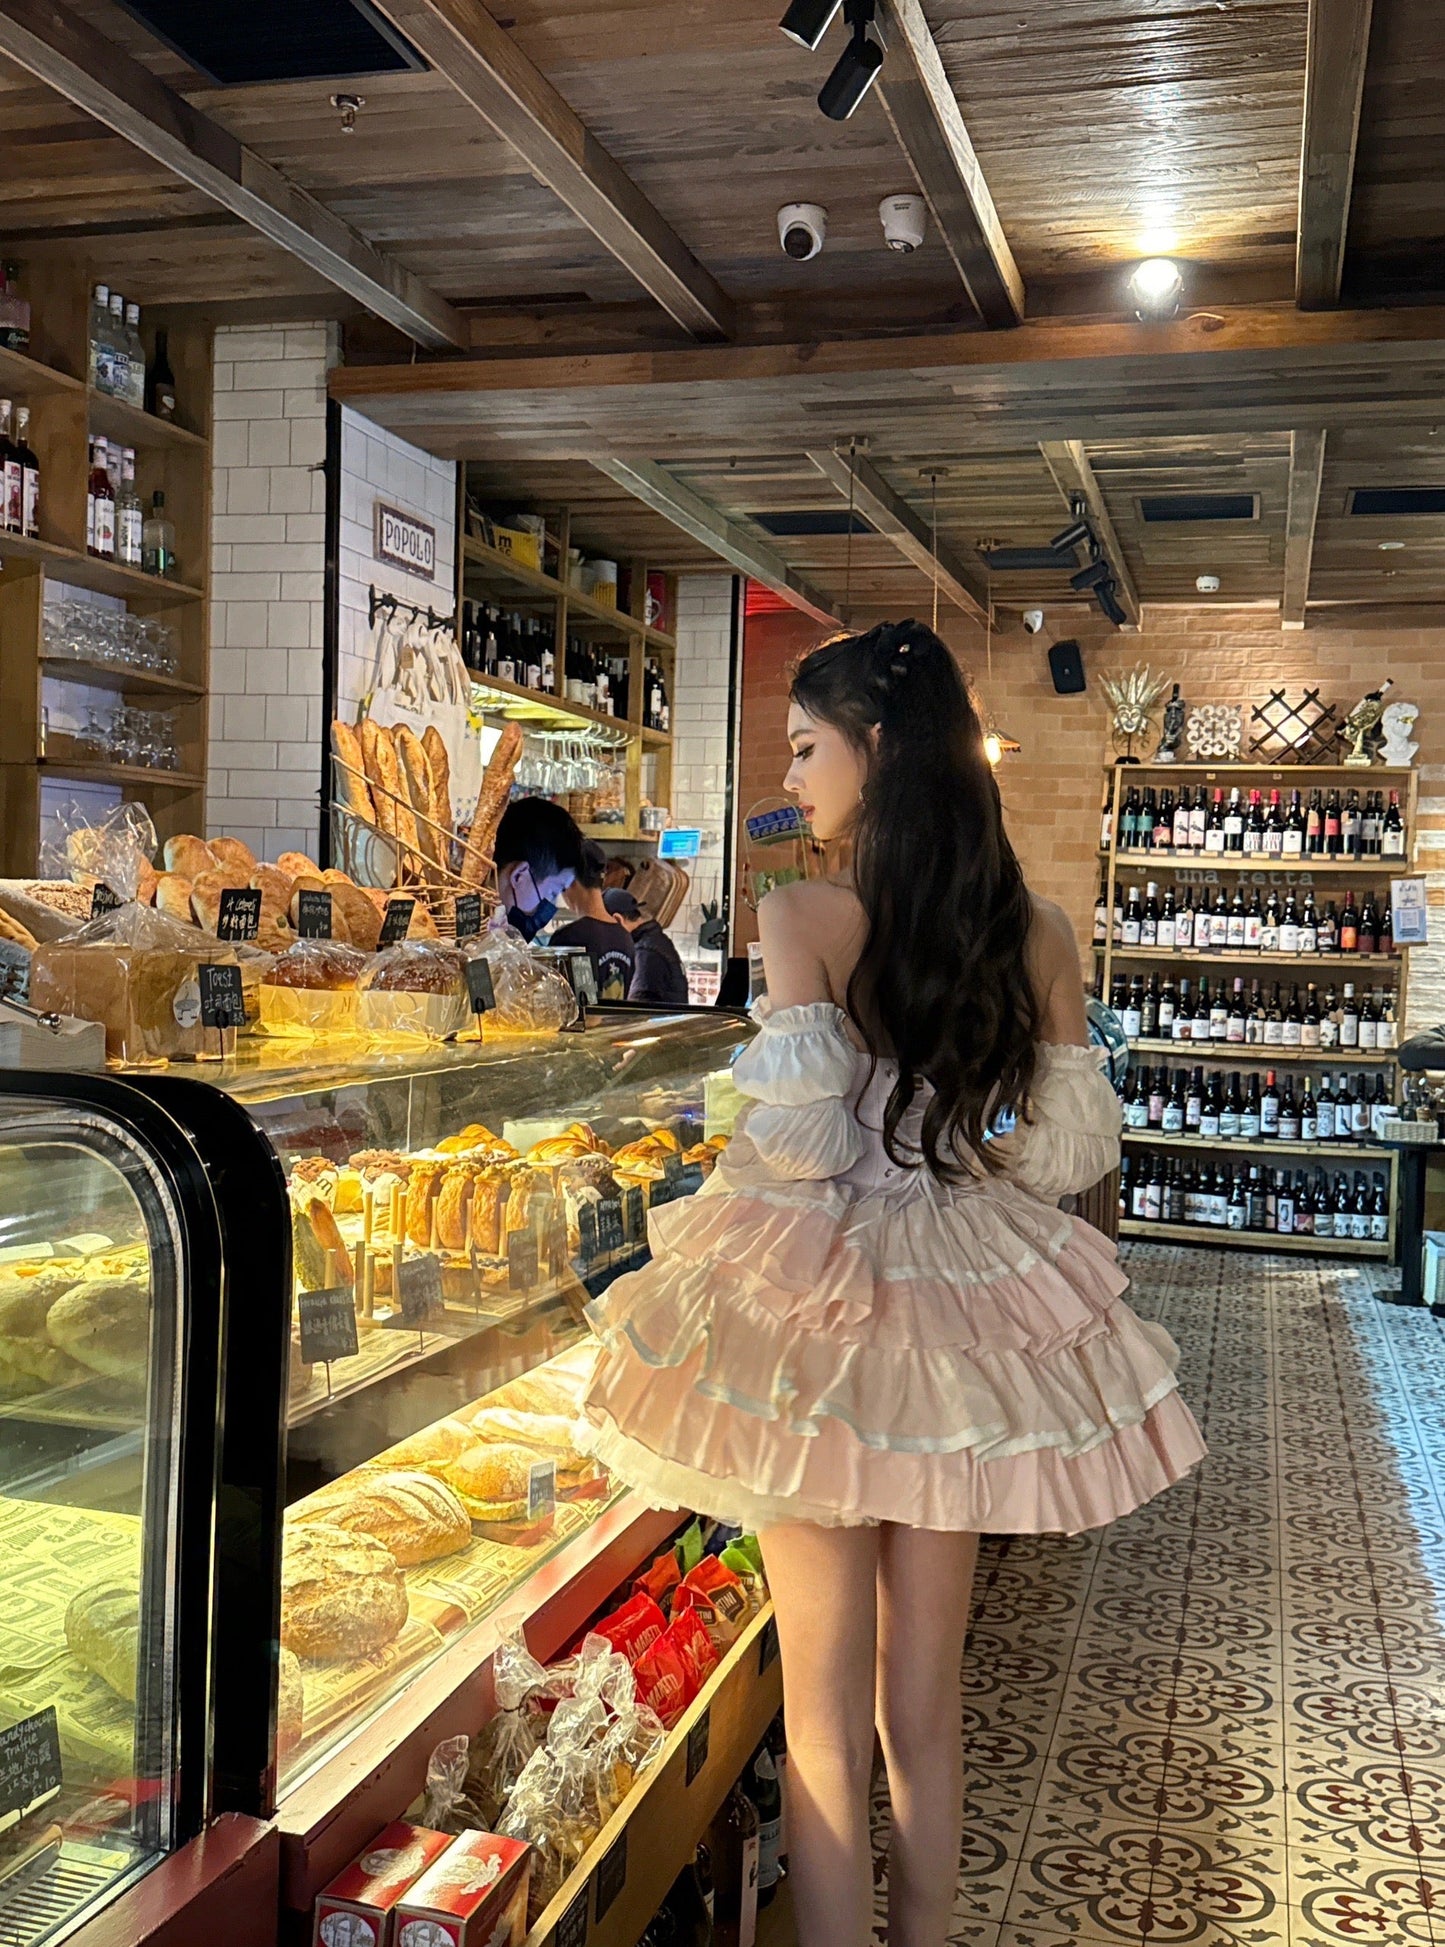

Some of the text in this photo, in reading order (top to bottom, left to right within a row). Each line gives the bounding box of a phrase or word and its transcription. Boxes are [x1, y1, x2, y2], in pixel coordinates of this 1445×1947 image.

[385, 519, 431, 564] POPOLO
[1174, 869, 1219, 884] una
[206, 967, 233, 991] Toast
[204, 991, 243, 1013] 吐司面包
